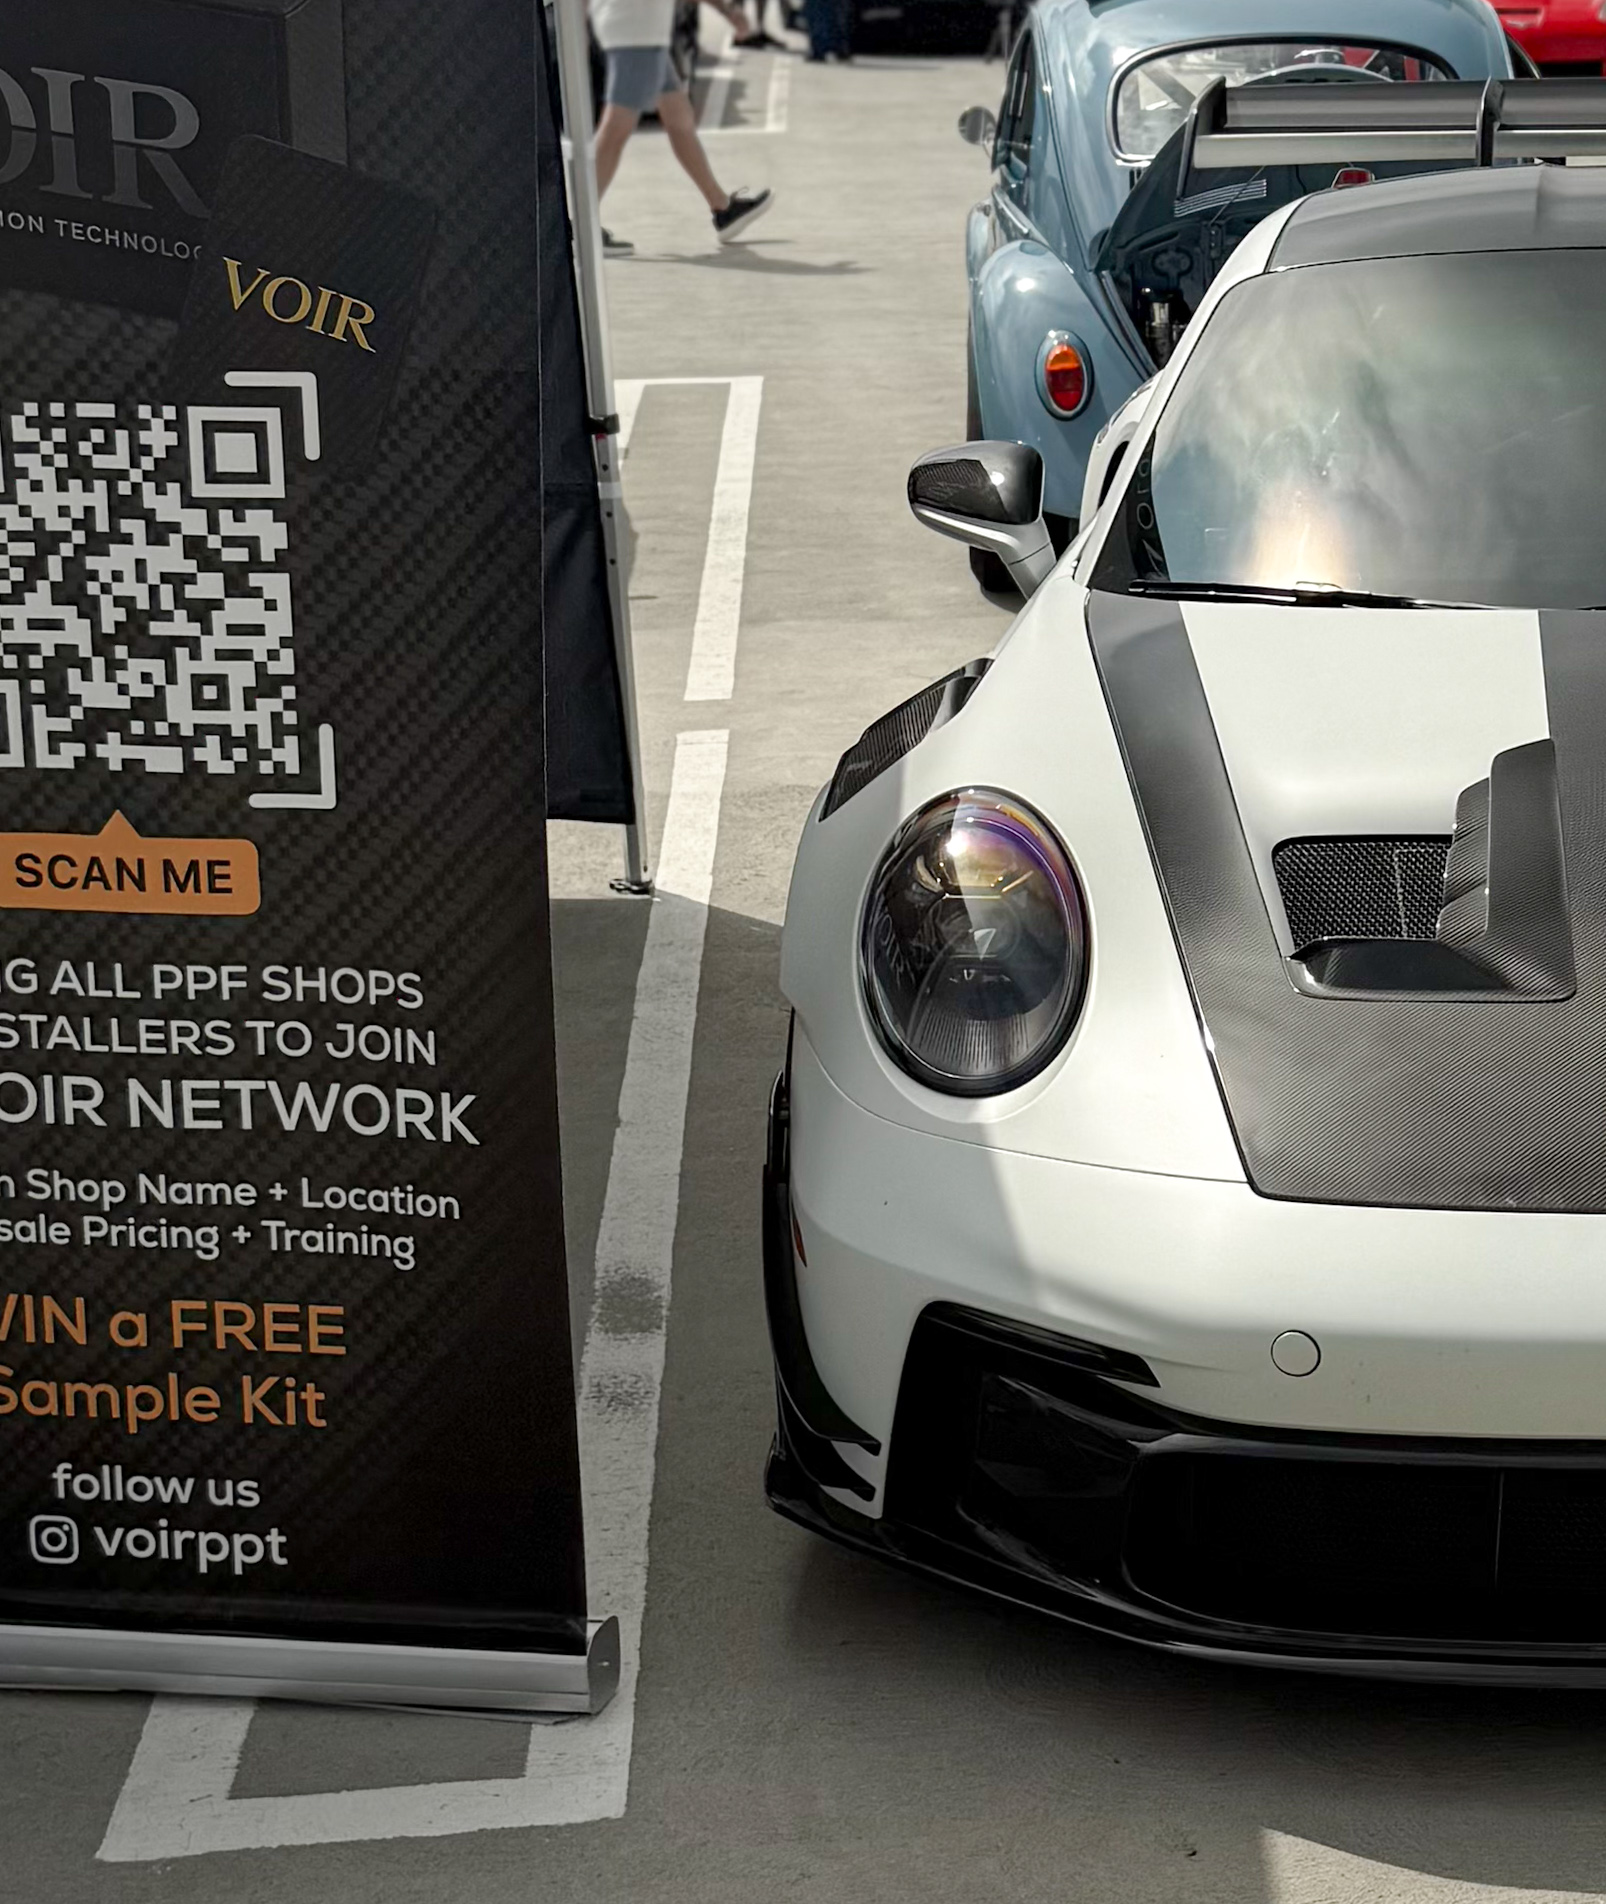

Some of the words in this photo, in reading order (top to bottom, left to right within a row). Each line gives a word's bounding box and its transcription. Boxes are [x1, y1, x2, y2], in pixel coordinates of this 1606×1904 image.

[222, 256, 377, 353] VOIR
[14, 852, 147, 893] SCAN
[162, 858, 233, 894] ME
[0, 957, 38, 994] G
[50, 960, 142, 999] ALL
[152, 964, 248, 1001] PPF
[261, 965, 424, 1009] SHOPS
[0, 1012, 235, 1056] STALLERS
[245, 1020, 312, 1057] TO
[325, 1022, 436, 1066] JOIN
[127, 1077, 480, 1145] NETWORK
[26, 1168, 126, 1212] Shop
[138, 1173, 257, 1206] Name
[268, 1182, 288, 1201] +
[301, 1177, 460, 1220] Location
[0, 1213, 72, 1245] sale
[82, 1215, 220, 1261] Pricing
[231, 1225, 252, 1244] +
[260, 1220, 416, 1271] Training
[0, 1293, 87, 1345] IN
[109, 1311, 148, 1347] a
[171, 1299, 347, 1355] FREE
[241, 1375, 327, 1428] Kit
[51, 1462, 195, 1504] follow
[207, 1478, 260, 1508] us
[93, 1518, 289, 1576] voirppt
